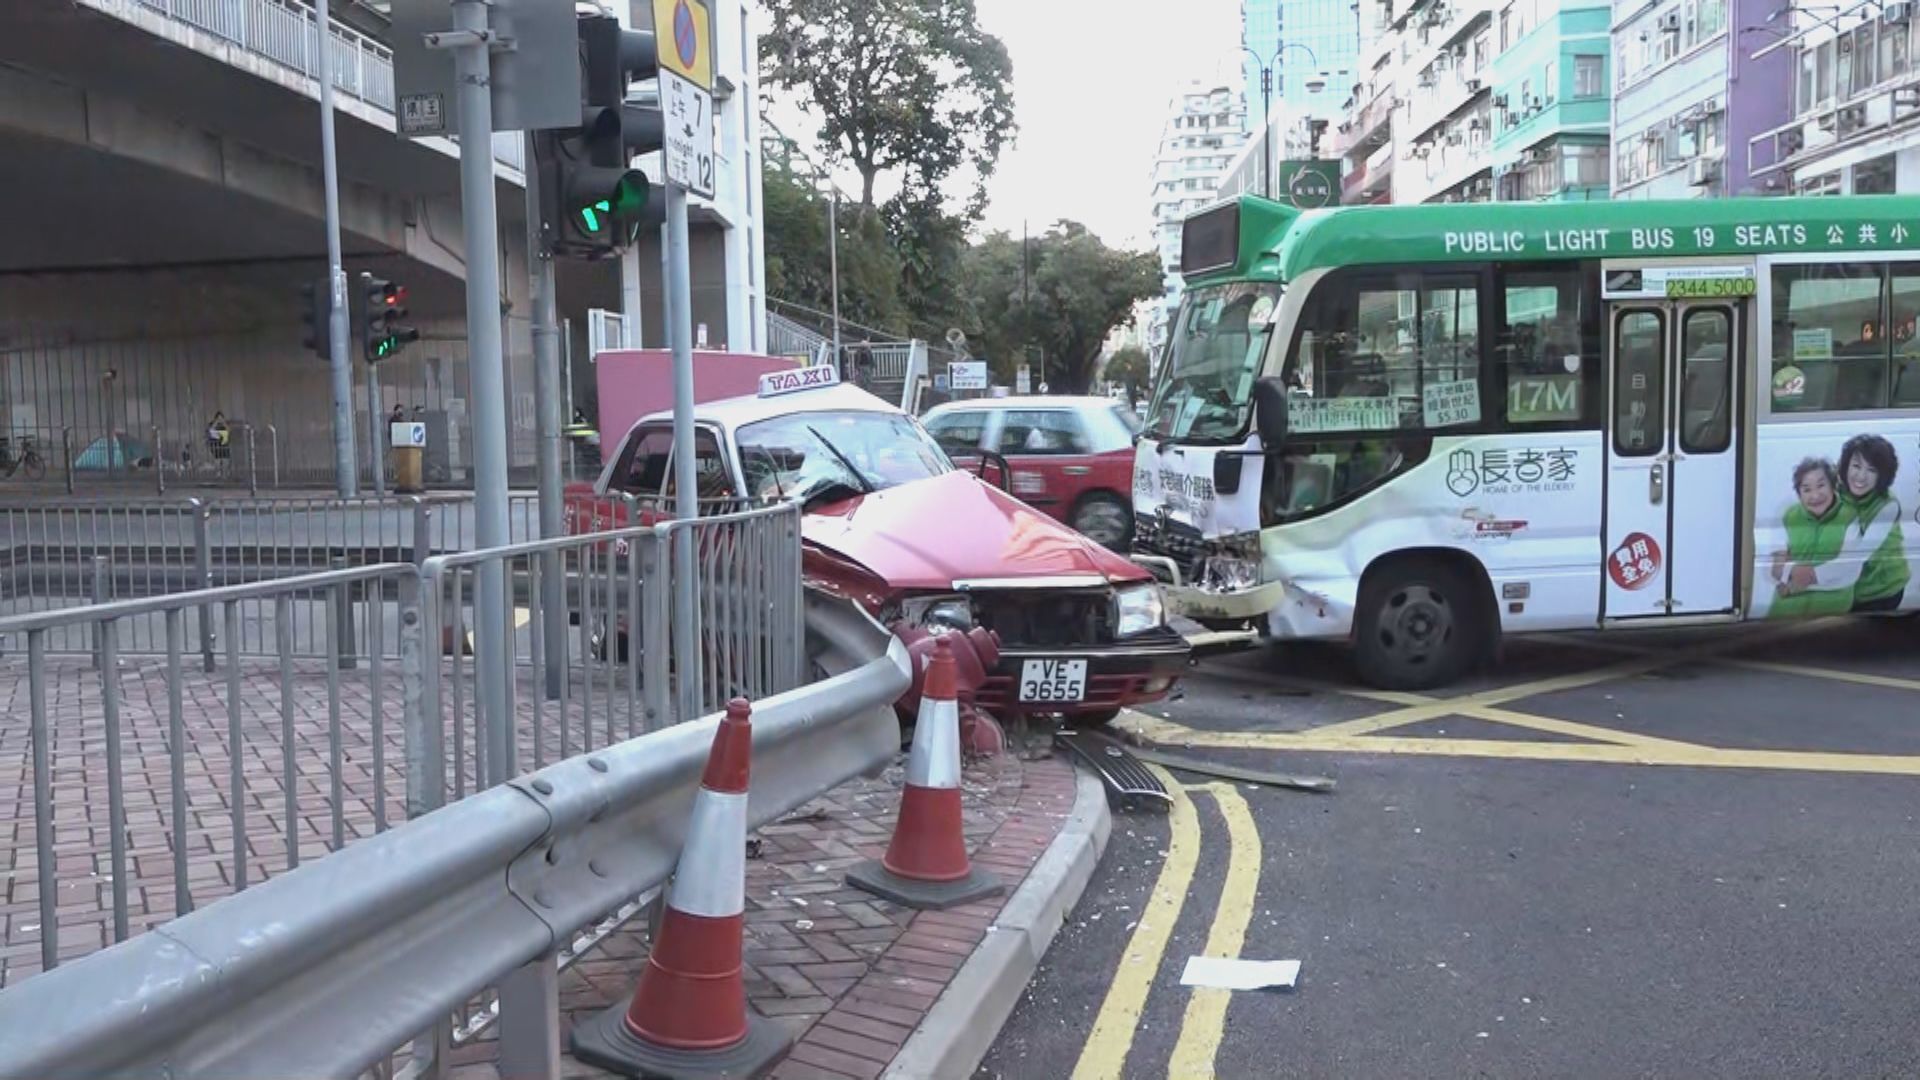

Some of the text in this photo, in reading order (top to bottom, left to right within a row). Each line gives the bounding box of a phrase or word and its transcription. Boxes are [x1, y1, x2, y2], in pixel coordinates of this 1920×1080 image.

[694, 91, 702, 128] 7
[668, 136, 694, 158] dnight
[698, 152, 712, 190] 12
[1445, 224, 1807, 253] PUBLIC LIGHT BUS 19 SEATS
[1667, 280, 1708, 297] 2344
[1714, 278, 1756, 295] 5000
[768, 368, 832, 391] TAXI
[1510, 380, 1578, 412] 17M
[1480, 446, 1578, 485] 長者家
[1482, 482, 1576, 495] HOME OF THE ELDERLY
[1043, 660, 1070, 679] VE
[1024, 681, 1081, 700] 3655
